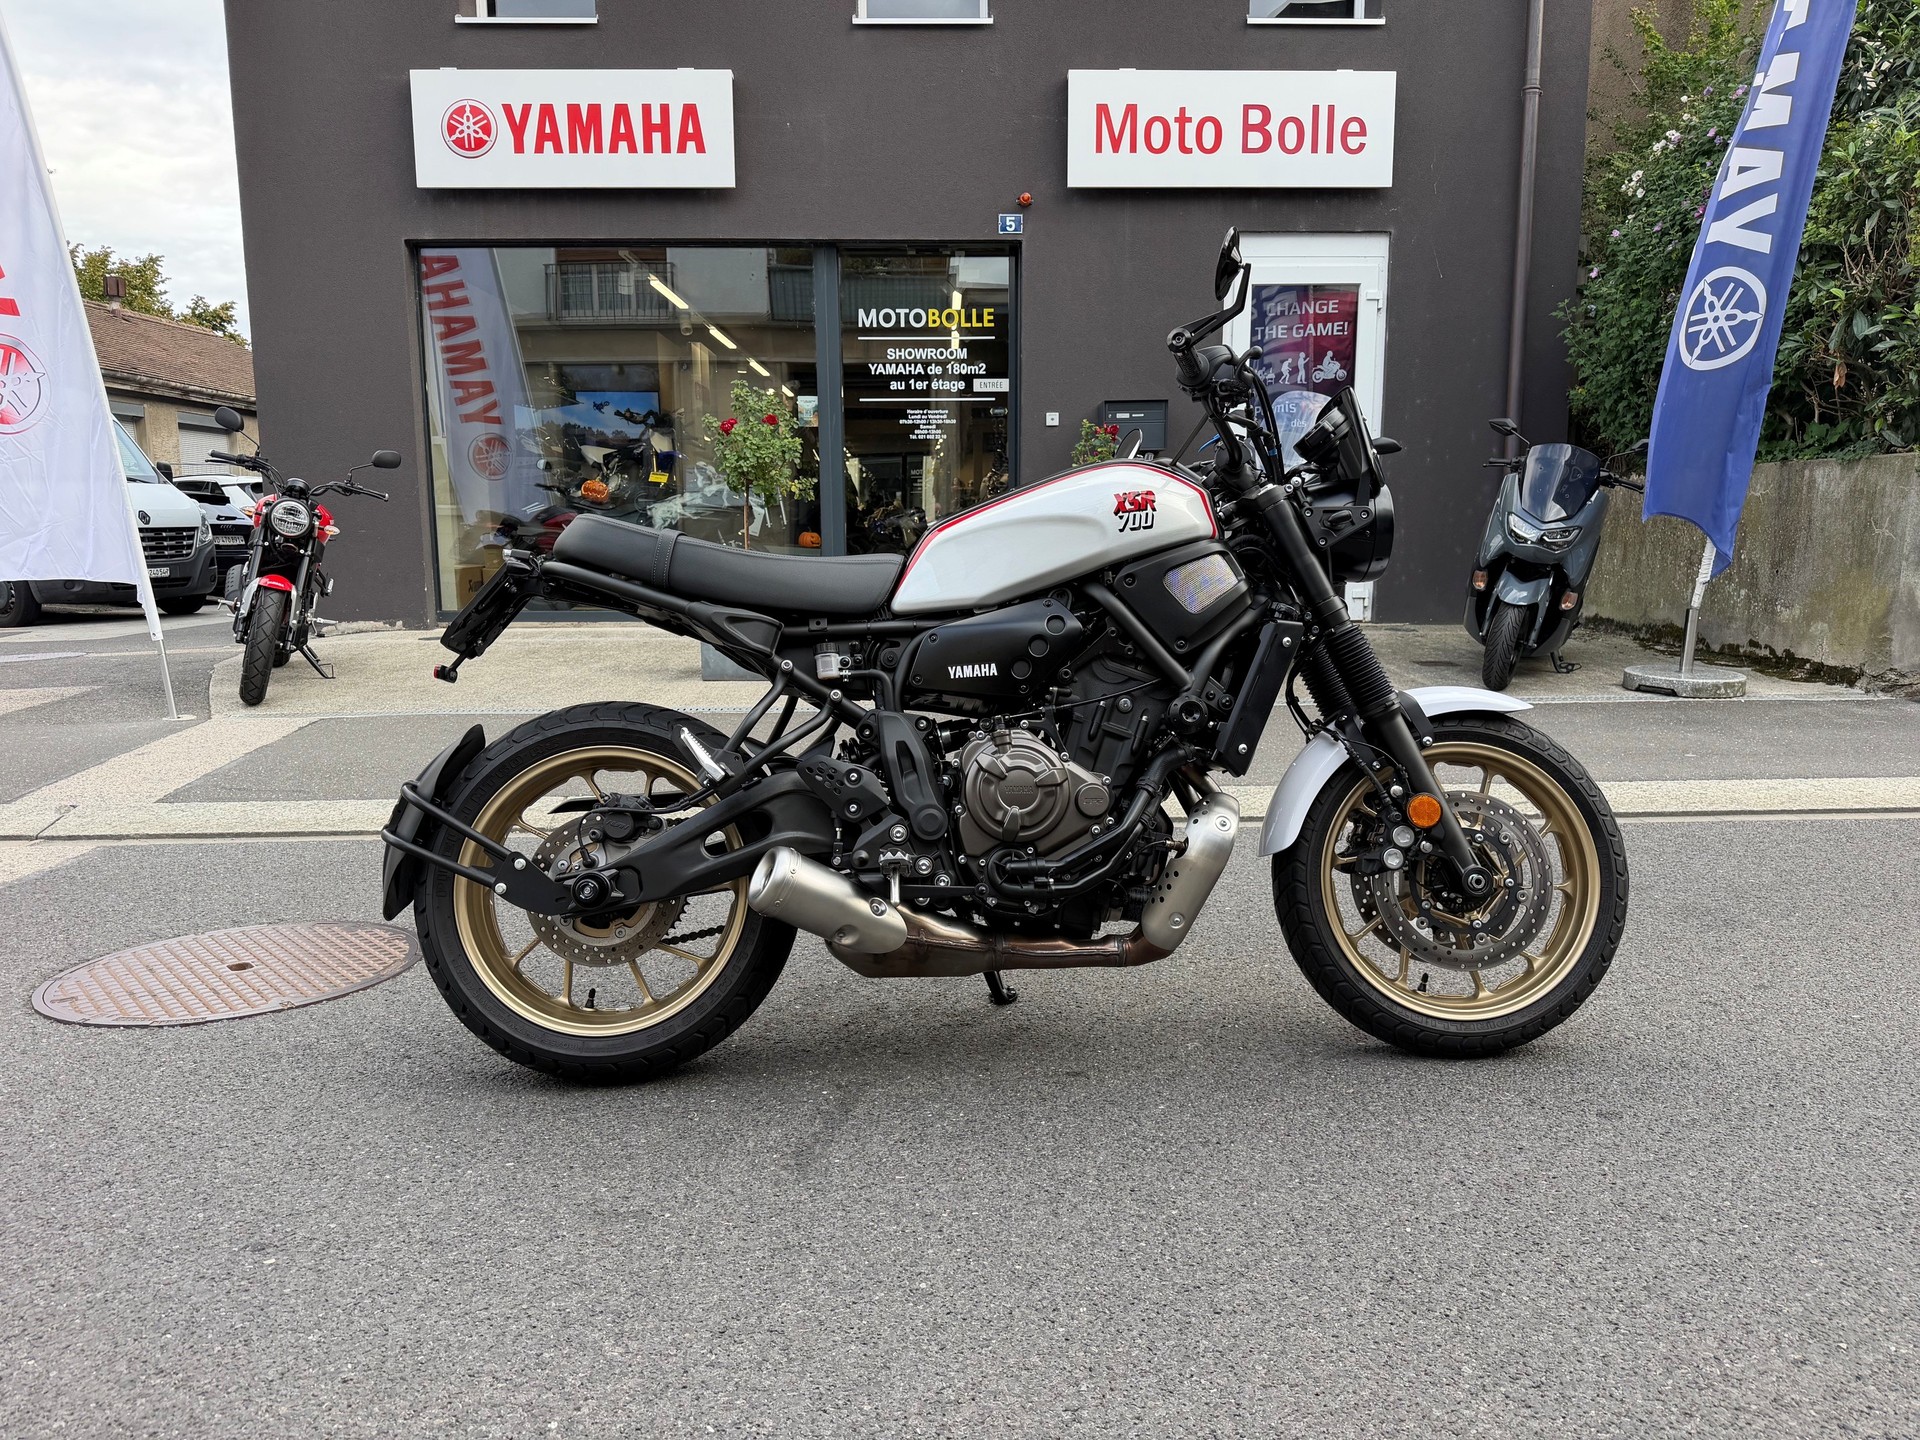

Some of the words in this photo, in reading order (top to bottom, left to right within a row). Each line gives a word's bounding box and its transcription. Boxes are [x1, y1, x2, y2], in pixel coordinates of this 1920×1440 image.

[501, 103, 706, 154] YAMAHA
[1095, 103, 1223, 155] Moto
[1241, 104, 1367, 155] Bolle
[1006, 216, 1015, 231] 5
[1266, 299, 1339, 317] CHANGE
[857, 308, 995, 328] MOTOBOLLE
[1255, 324, 1288, 340] THE
[1292, 321, 1349, 339] GAME!
[886, 348, 968, 360] SHOWROOM
[868, 363, 924, 375] YAMAHA
[927, 363, 943, 375] de
[946, 363, 987, 375] 180m2
[889, 380, 905, 390] au
[909, 379, 927, 390] 1er
[932, 378, 966, 392] étage
[979, 379, 1004, 389] ENTRÉE
[1290, 418, 1307, 428] dès
[1113, 490, 1157, 516] XSR
[1118, 511, 1155, 533] 700
[947, 663, 998, 679] YAMAHA
